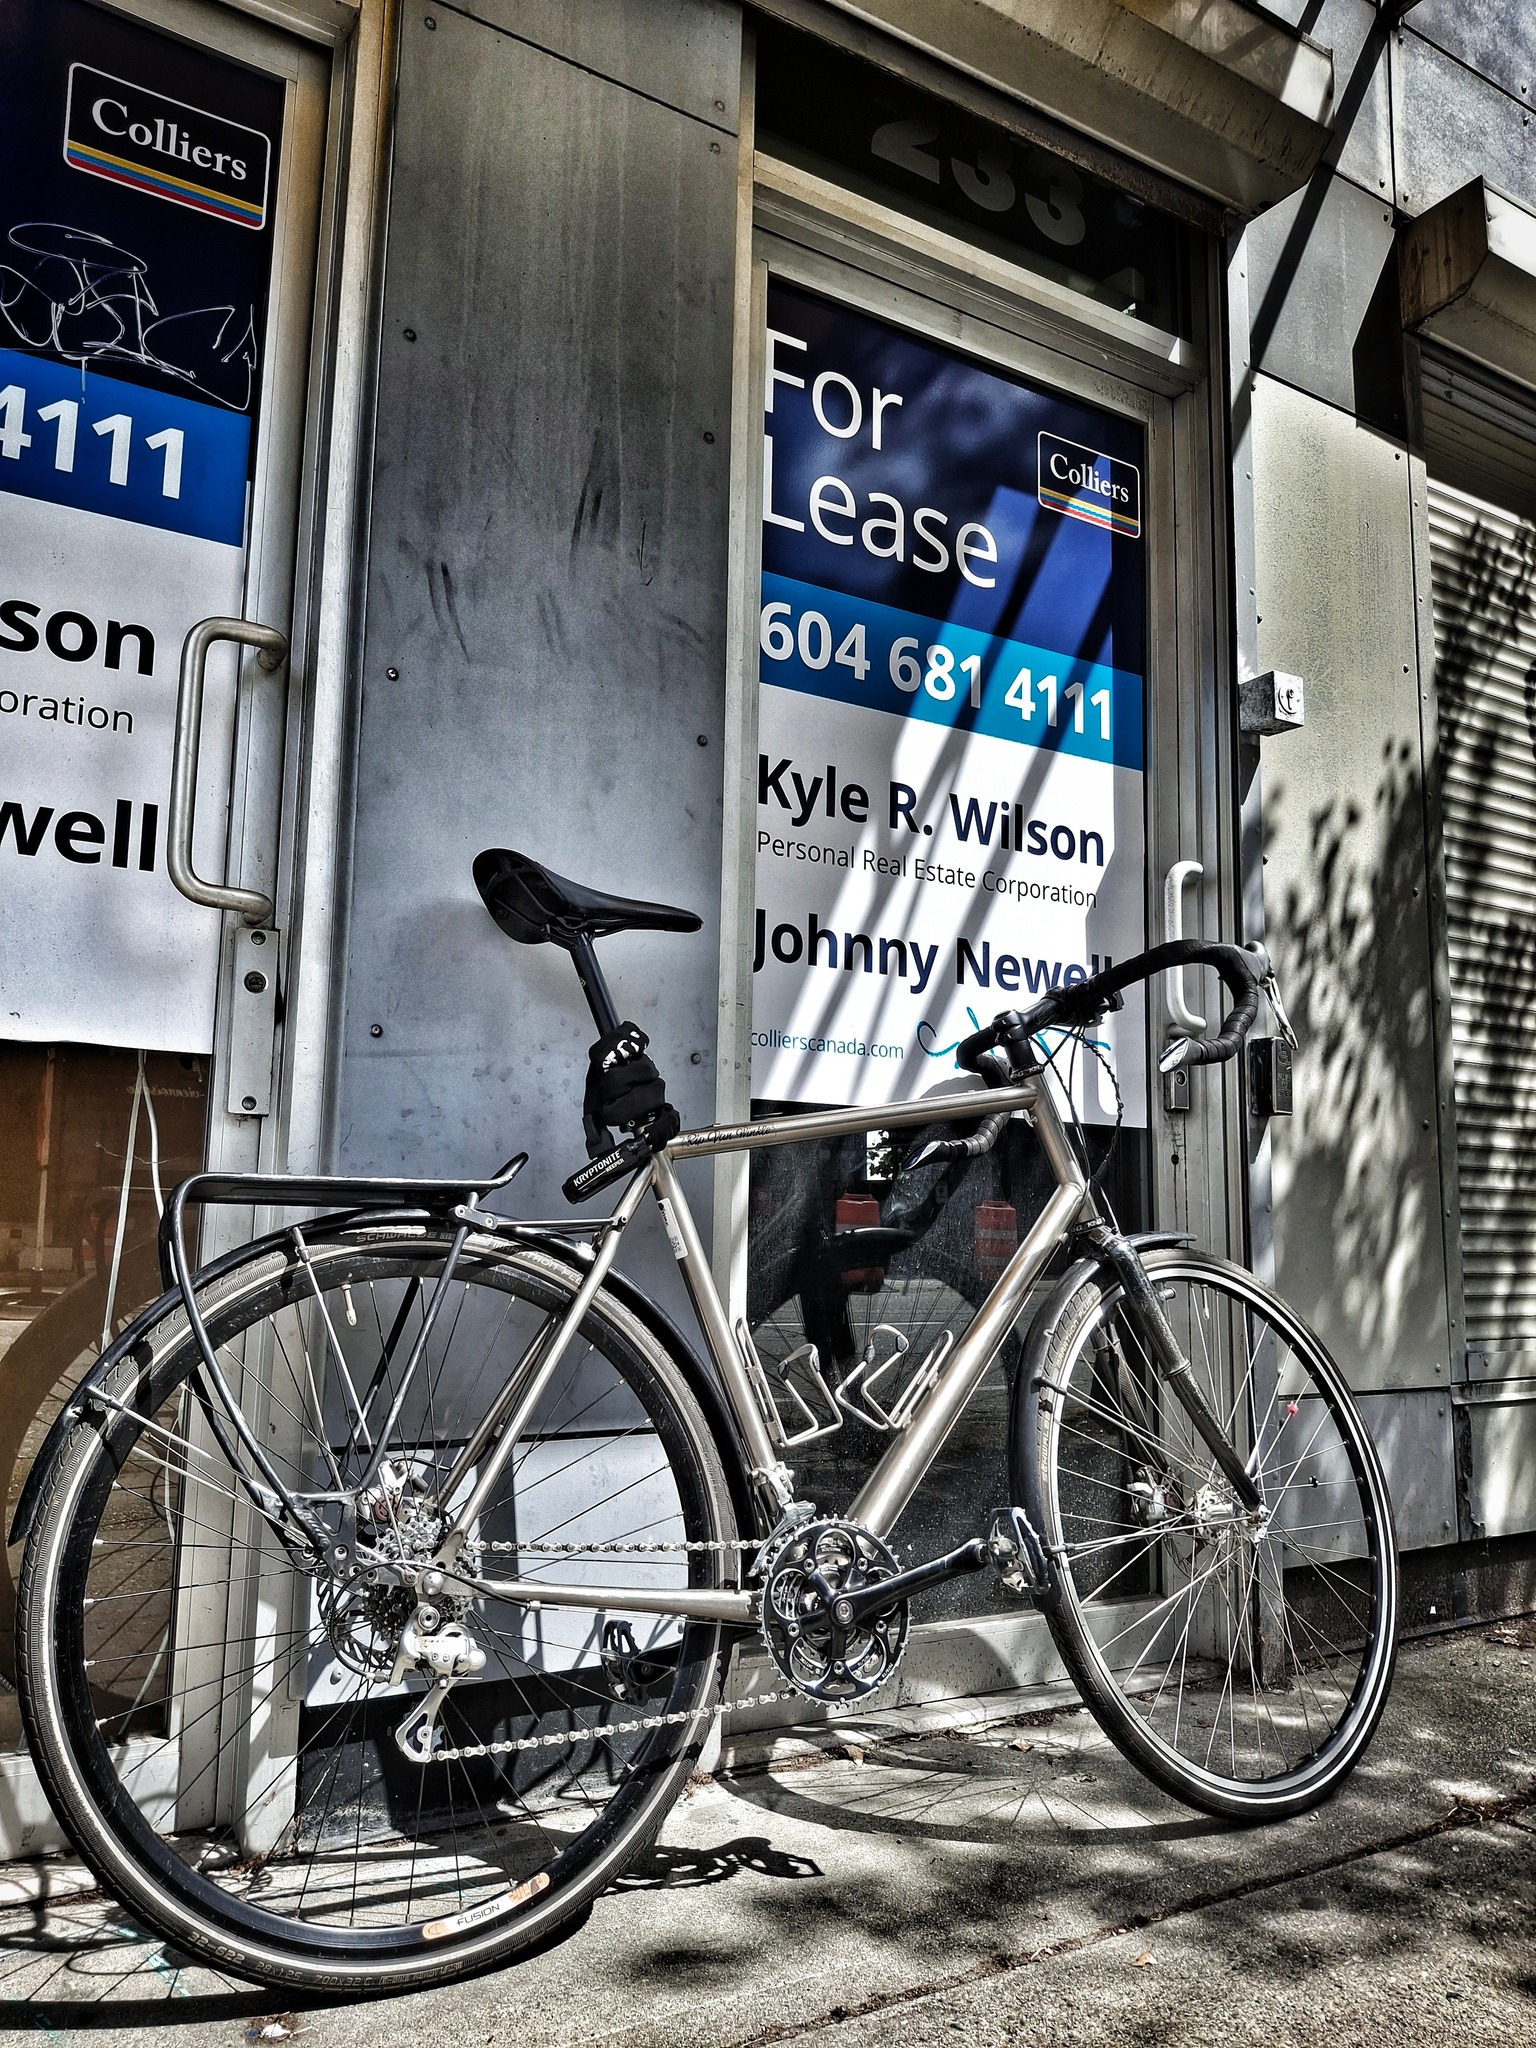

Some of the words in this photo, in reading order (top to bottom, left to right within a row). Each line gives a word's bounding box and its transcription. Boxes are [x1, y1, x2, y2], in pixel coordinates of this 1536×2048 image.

[92, 98, 247, 181] Colliers
[764, 328, 903, 450] For
[762, 436, 998, 589] Lease
[1050, 452, 1130, 503] Colliers
[760, 601, 871, 680] 604
[888, 636, 982, 709] 681
[1004, 667, 1111, 741] 4111
[758, 752, 869, 827] Kyle
[888, 780, 934, 837] R.
[949, 792, 1104, 867] Wilson
[757, 830, 855, 869] Personal
[863, 849, 907, 878] Real
[915, 859, 976, 889] Estate
[982, 870, 1098, 909] Corporation
[753, 908, 939, 993] Johnny
[956, 937, 1112, 993] Newe
[751, 1029, 905, 1061] collierscanada.com
[573, 1150, 621, 1187] KRYPTONITE
[457, 1902, 501, 1927] FUSION
